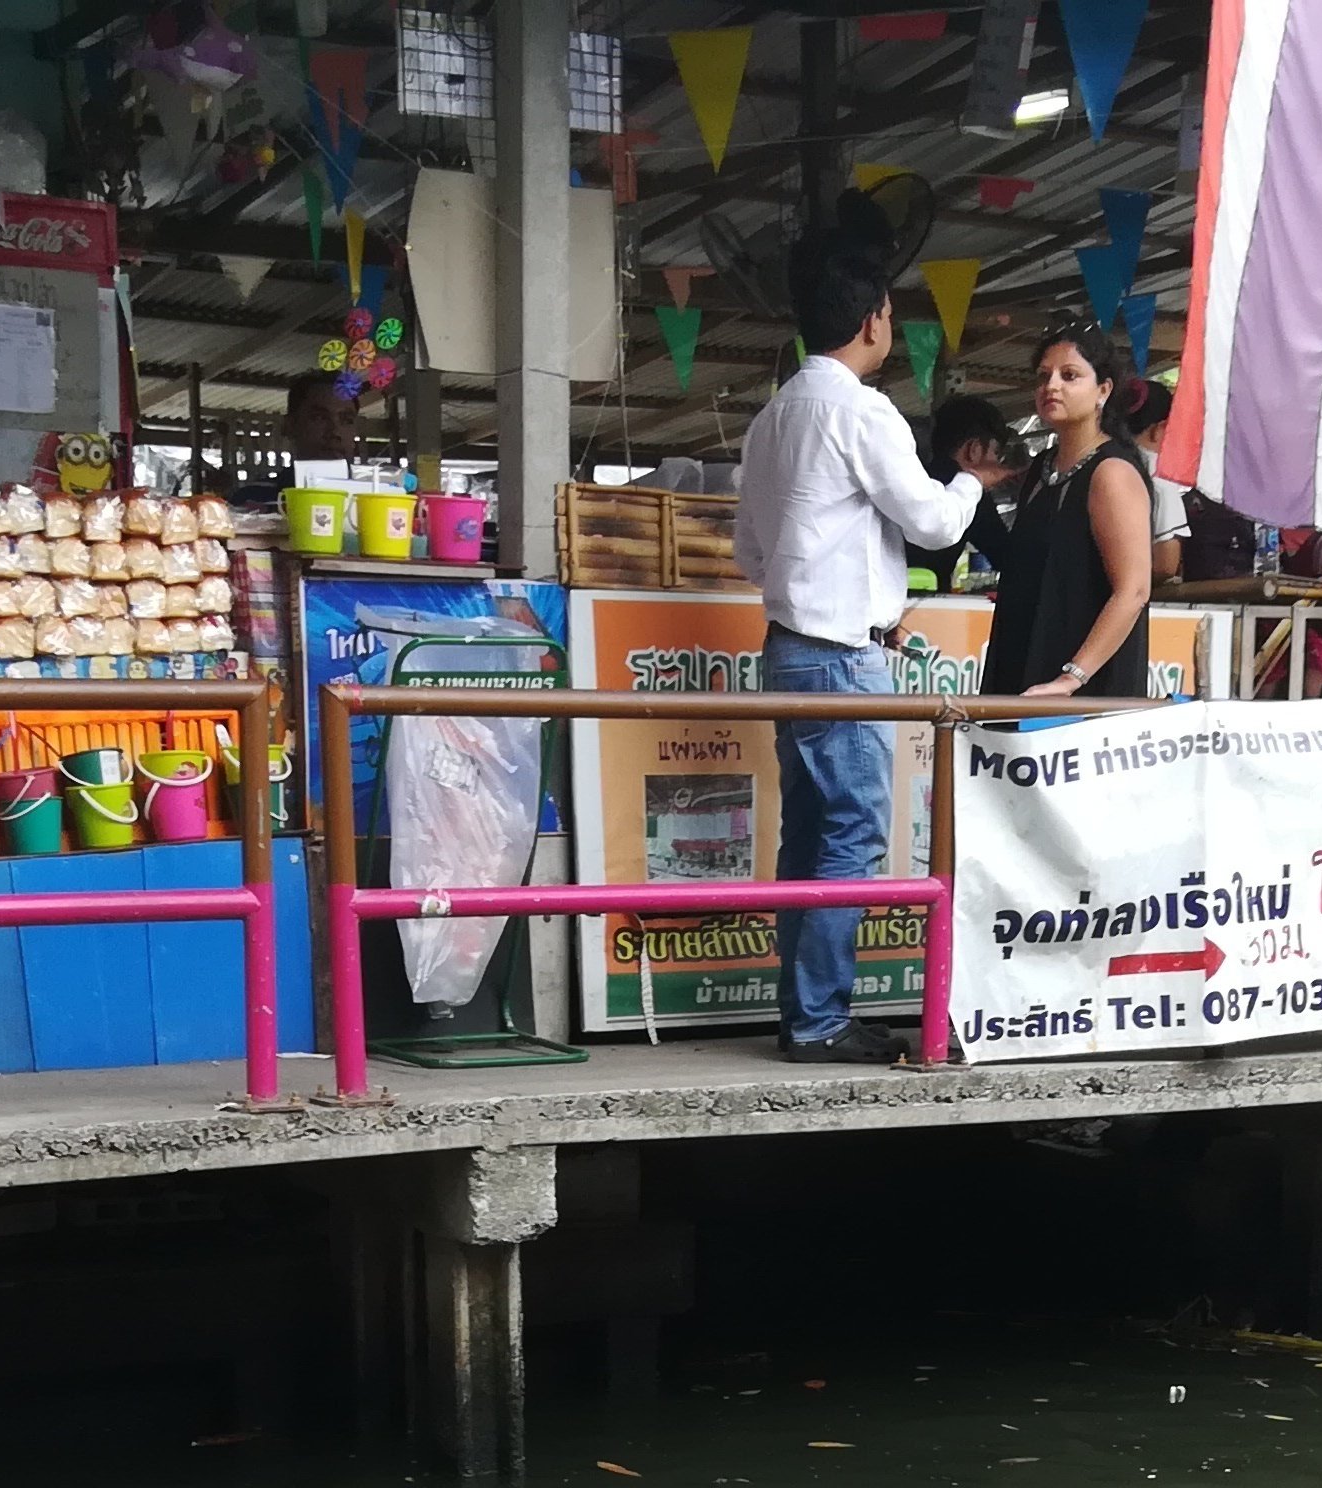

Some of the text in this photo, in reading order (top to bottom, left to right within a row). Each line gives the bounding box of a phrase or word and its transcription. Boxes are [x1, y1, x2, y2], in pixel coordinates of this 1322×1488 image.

[970, 743, 1081, 788] MOVE
[992, 863, 1292, 961] จุดท่าลงเรือใหม่
[1107, 994, 1186, 1031] Tel:
